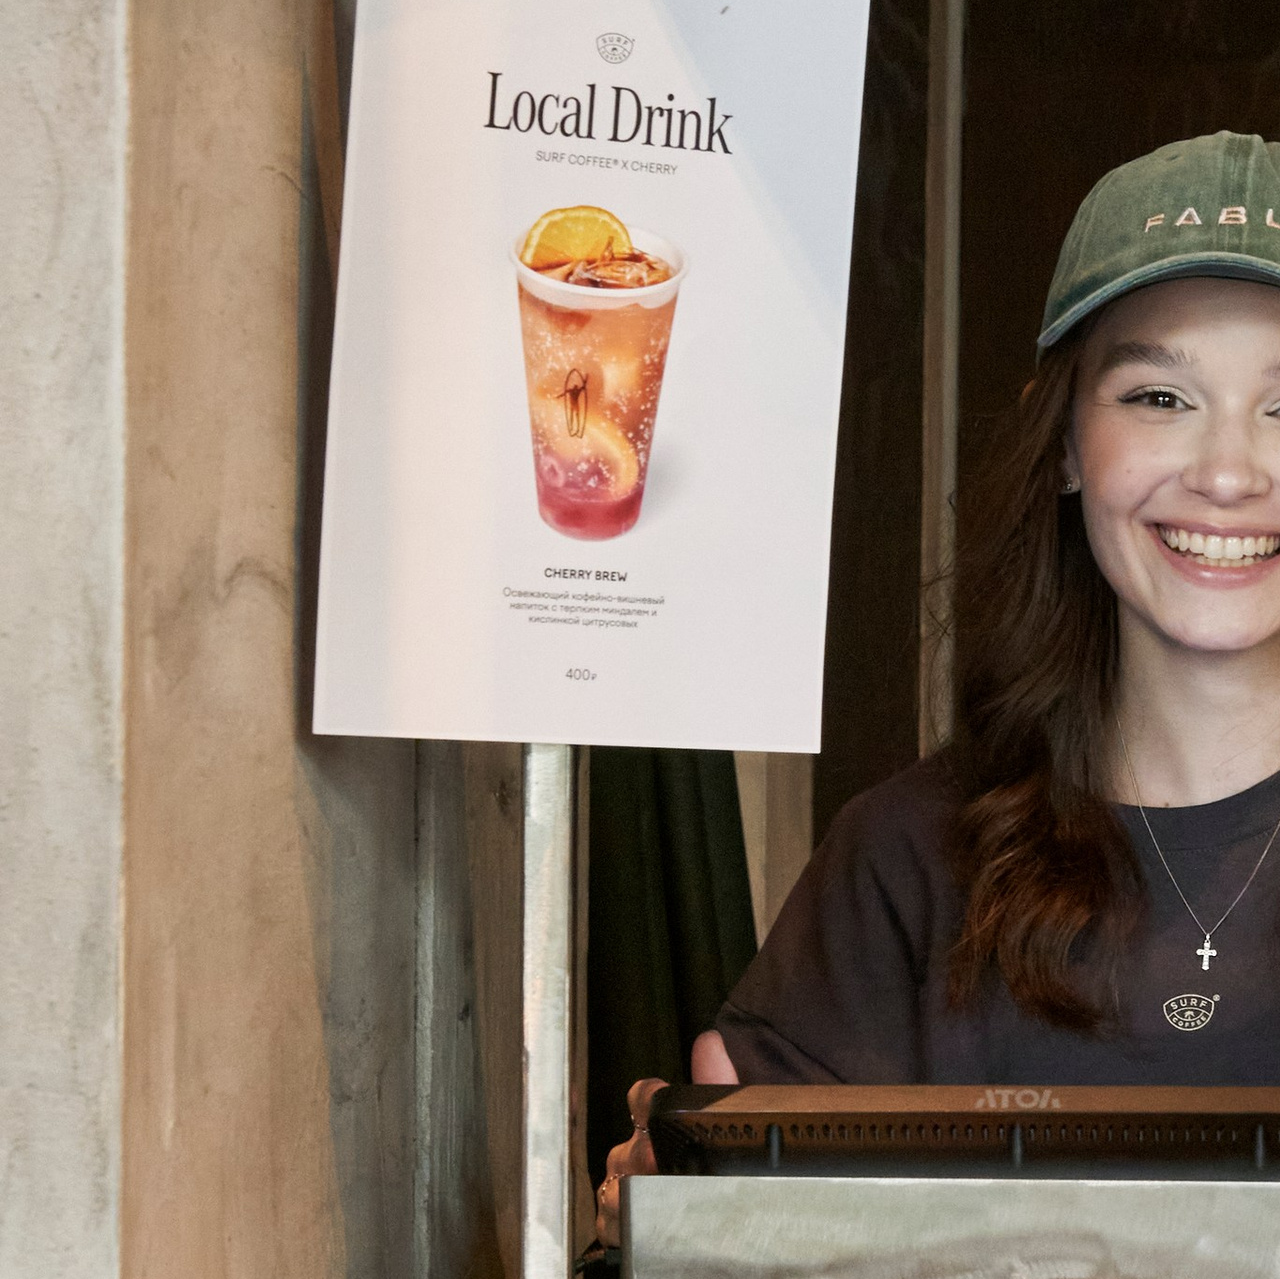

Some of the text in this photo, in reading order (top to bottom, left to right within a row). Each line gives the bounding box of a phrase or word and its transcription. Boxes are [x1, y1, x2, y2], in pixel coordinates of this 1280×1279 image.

[484, 71, 733, 155] Local Drink
[536, 150, 566, 164] SURF
[631, 160, 677, 175] CHERRY
[544, 567, 628, 582] CHERRY BREW
[503, 587, 665, 605] Освежающий кофейно-вишневый
[528, 615, 638, 629] кислинкой цитрусовых
[1170, 998, 1207, 1009] SURF
[1172, 1016, 1207, 1027] COFFEE
